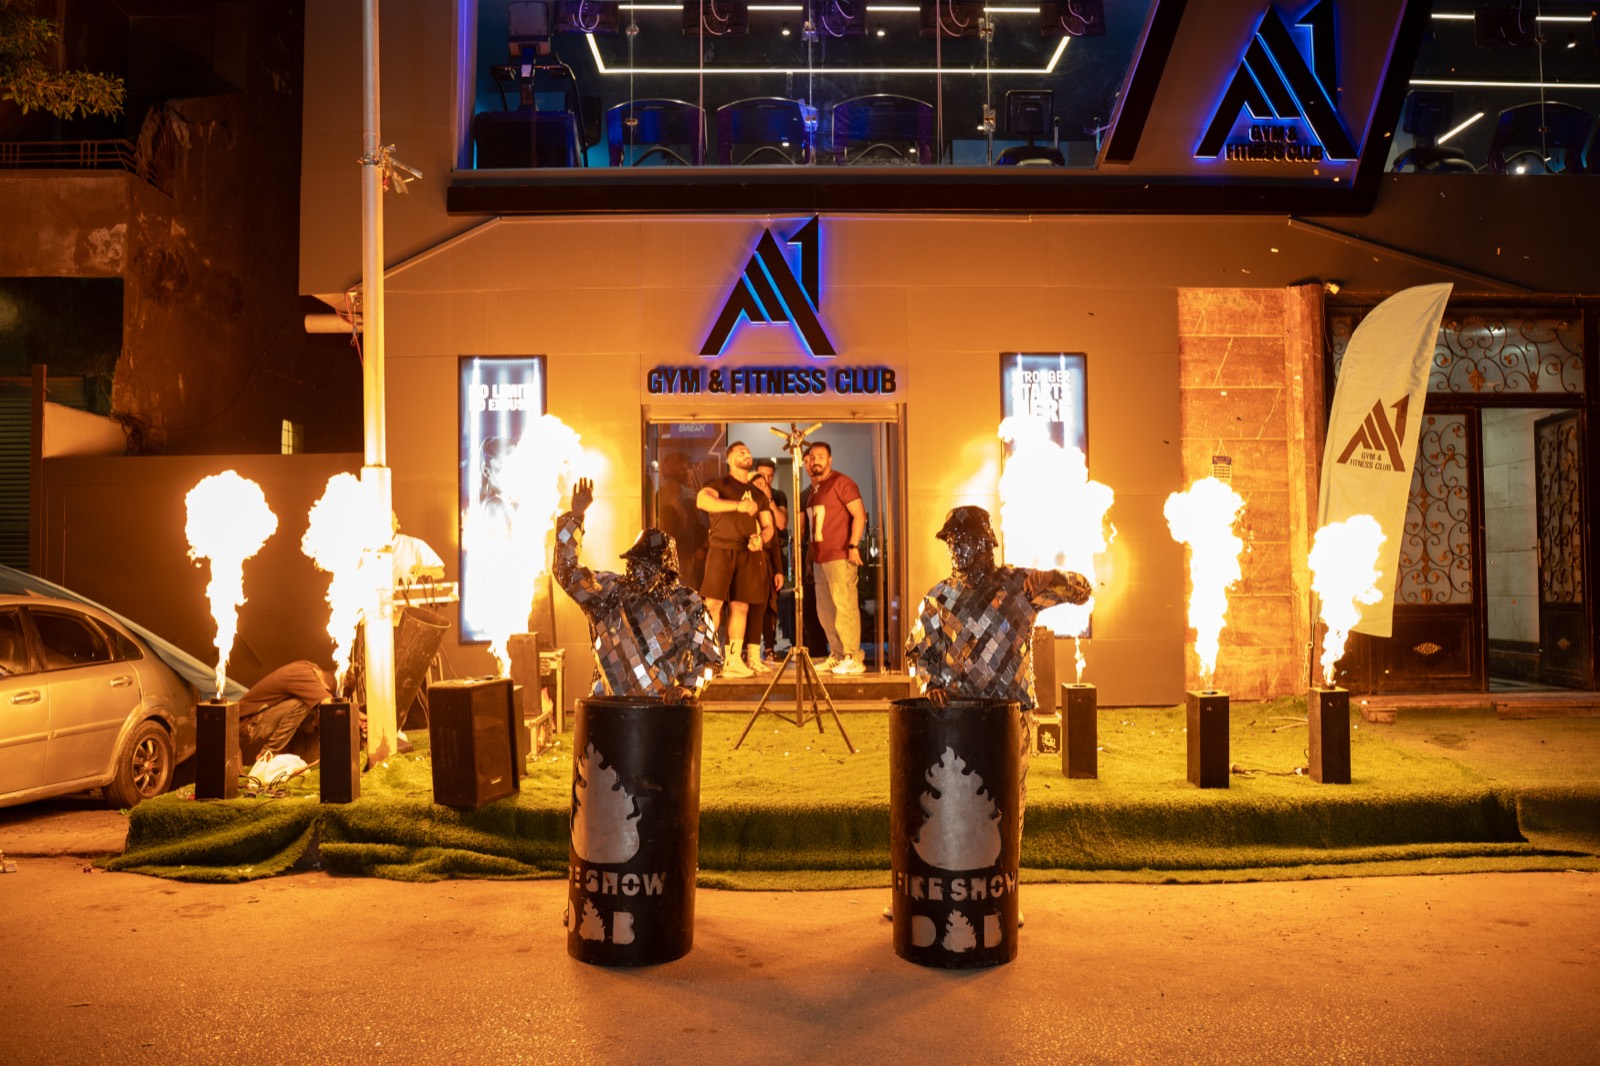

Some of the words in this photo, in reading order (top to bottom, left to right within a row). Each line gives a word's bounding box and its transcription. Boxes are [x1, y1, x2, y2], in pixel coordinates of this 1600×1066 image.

[1249, 125, 1284, 143] GYM
[1286, 126, 1297, 143] &
[1225, 144, 1283, 163] FITNESS
[1285, 145, 1323, 163] CLUB
[647, 368, 701, 394] GYM
[708, 368, 725, 394] &
[730, 368, 827, 395] FITNESS
[834, 368, 897, 395] CLUB
[1350, 459, 1373, 468] FITNESS
[1362, 452, 1375, 460] GYM
[585, 870, 667, 896] SHOW
